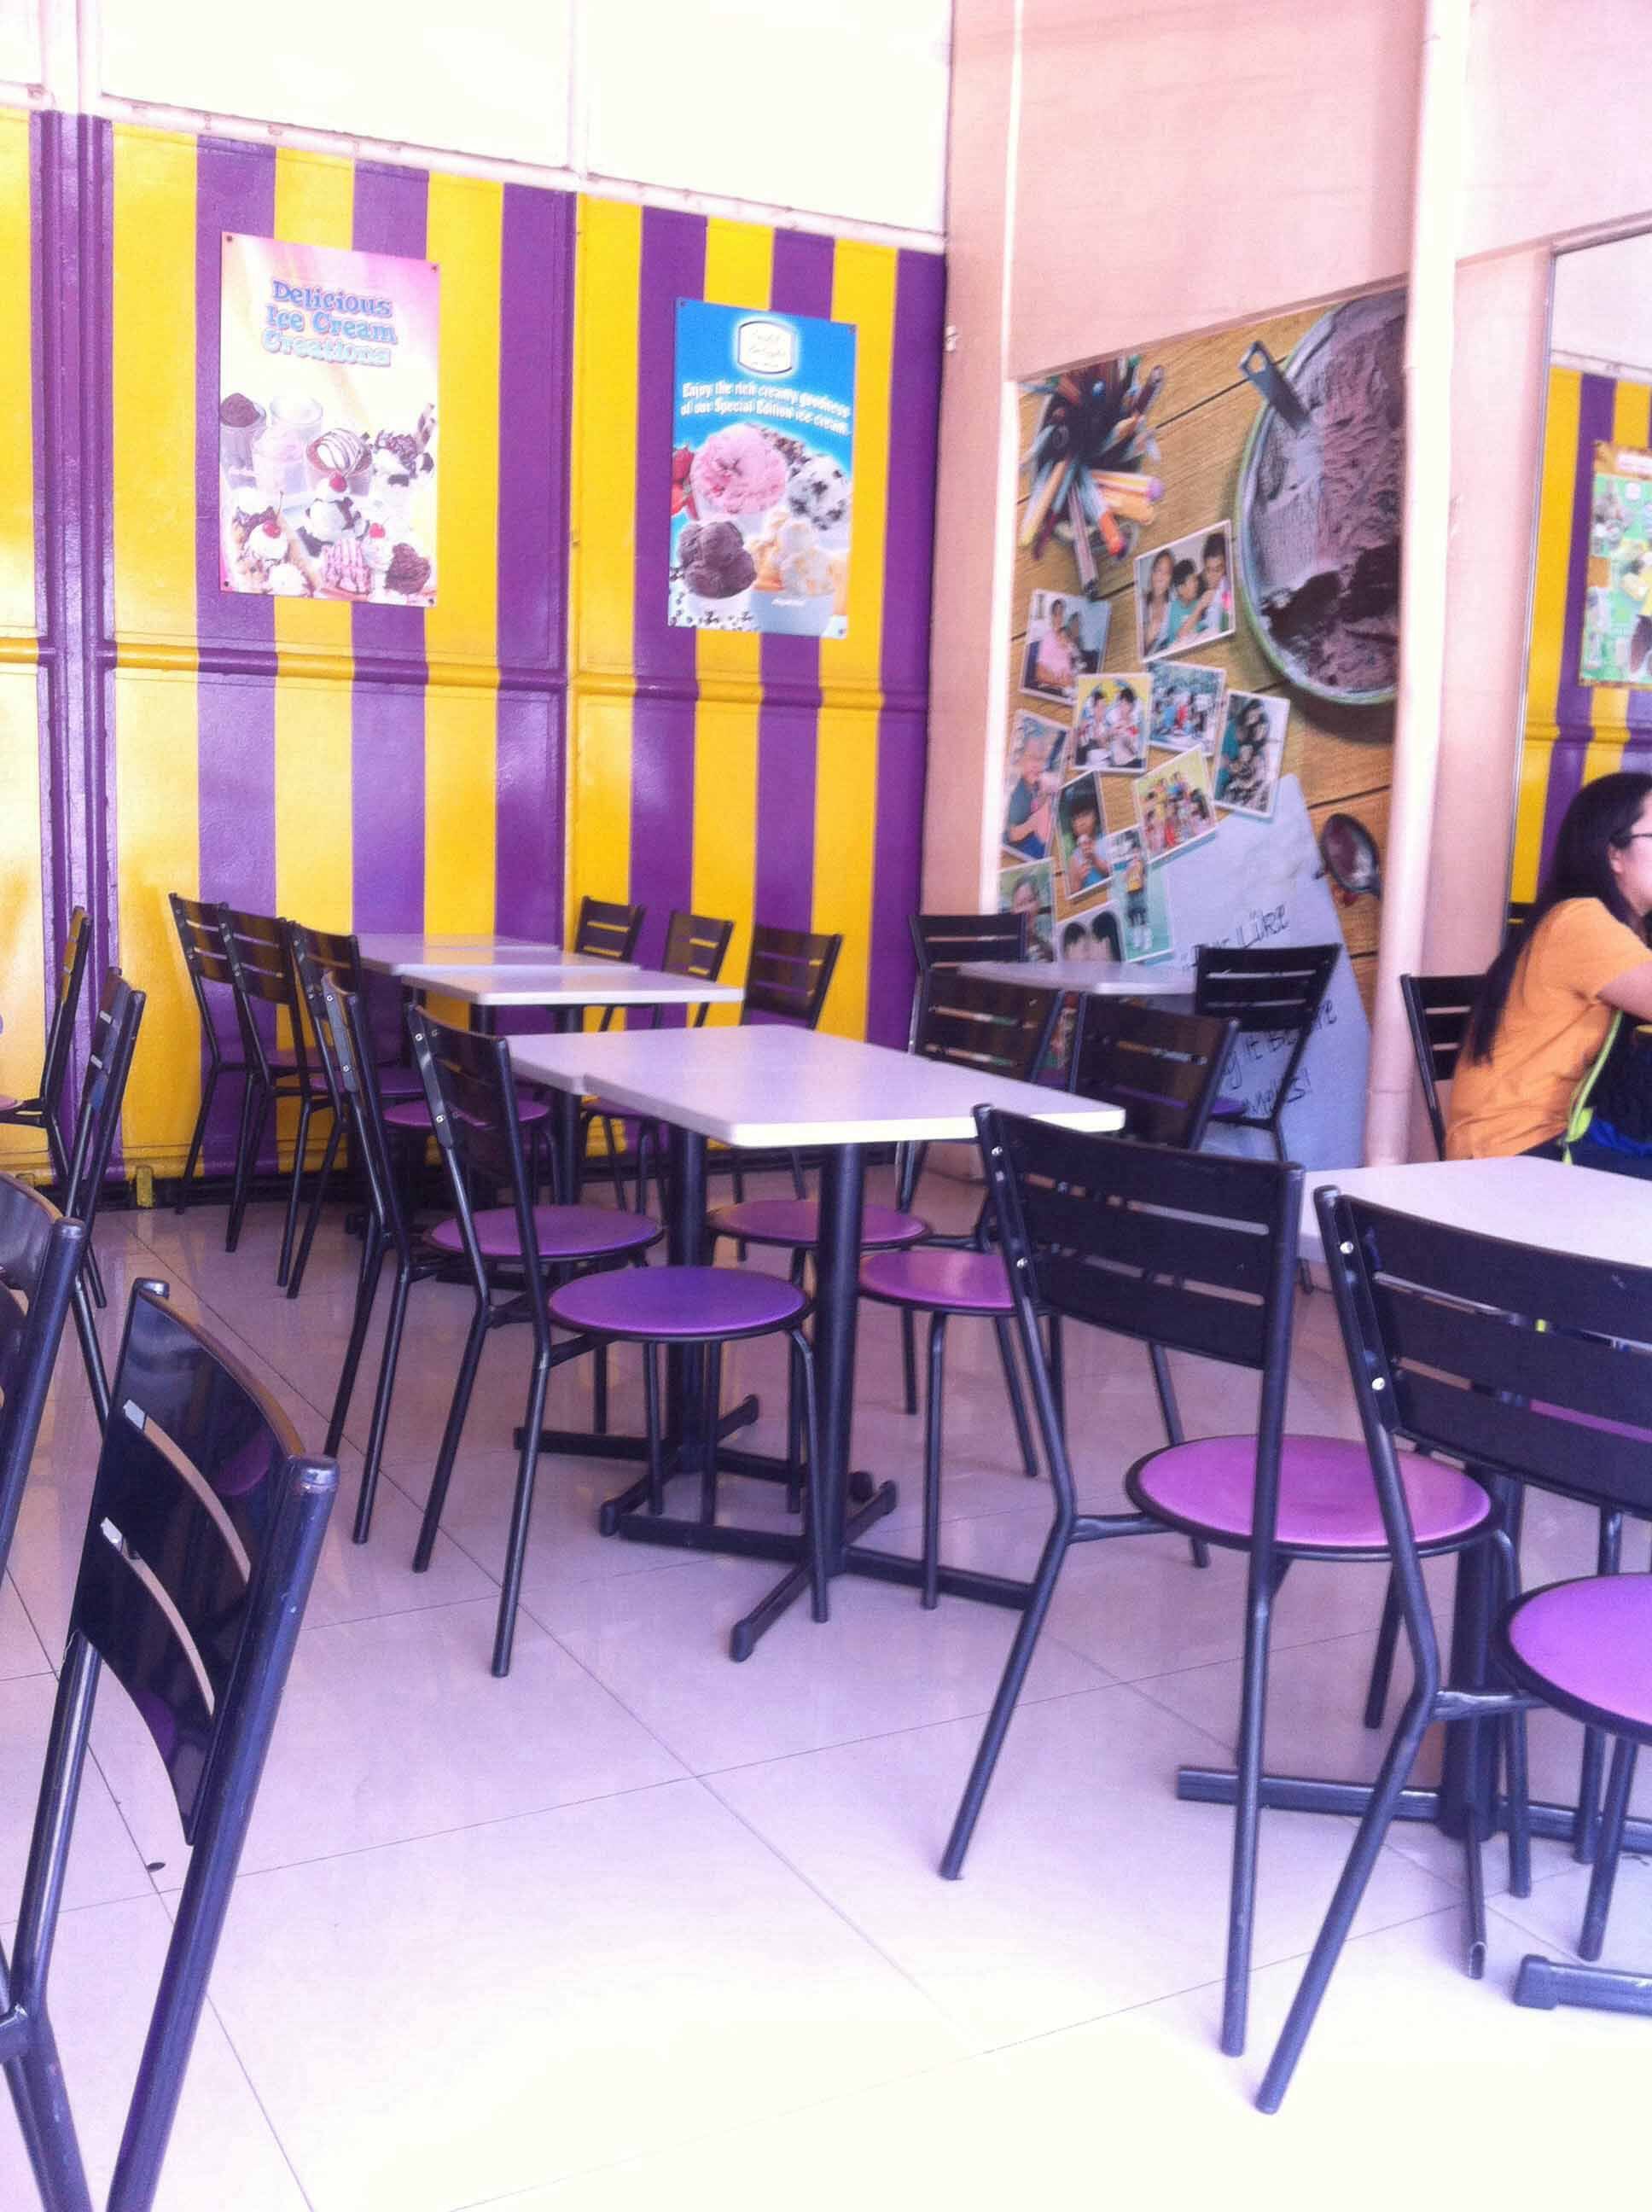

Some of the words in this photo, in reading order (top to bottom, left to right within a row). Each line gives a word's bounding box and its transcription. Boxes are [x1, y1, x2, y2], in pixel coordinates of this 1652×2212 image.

[272, 279, 393, 318] Delicious
[265, 304, 305, 332] Ice
[311, 311, 398, 345] Cream
[263, 328, 392, 367] Creations
[680, 401, 694, 416] of
[694, 403, 712, 415] our
[714, 397, 755, 416] Special
[756, 400, 794, 420] Edition
[794, 410, 814, 423] ice
[682, 382, 713, 399] Enjoy
[715, 381, 732, 395] the
[735, 381, 757, 396] rich
[758, 385, 799, 405] creamy
[799, 392, 851, 418] goodness
